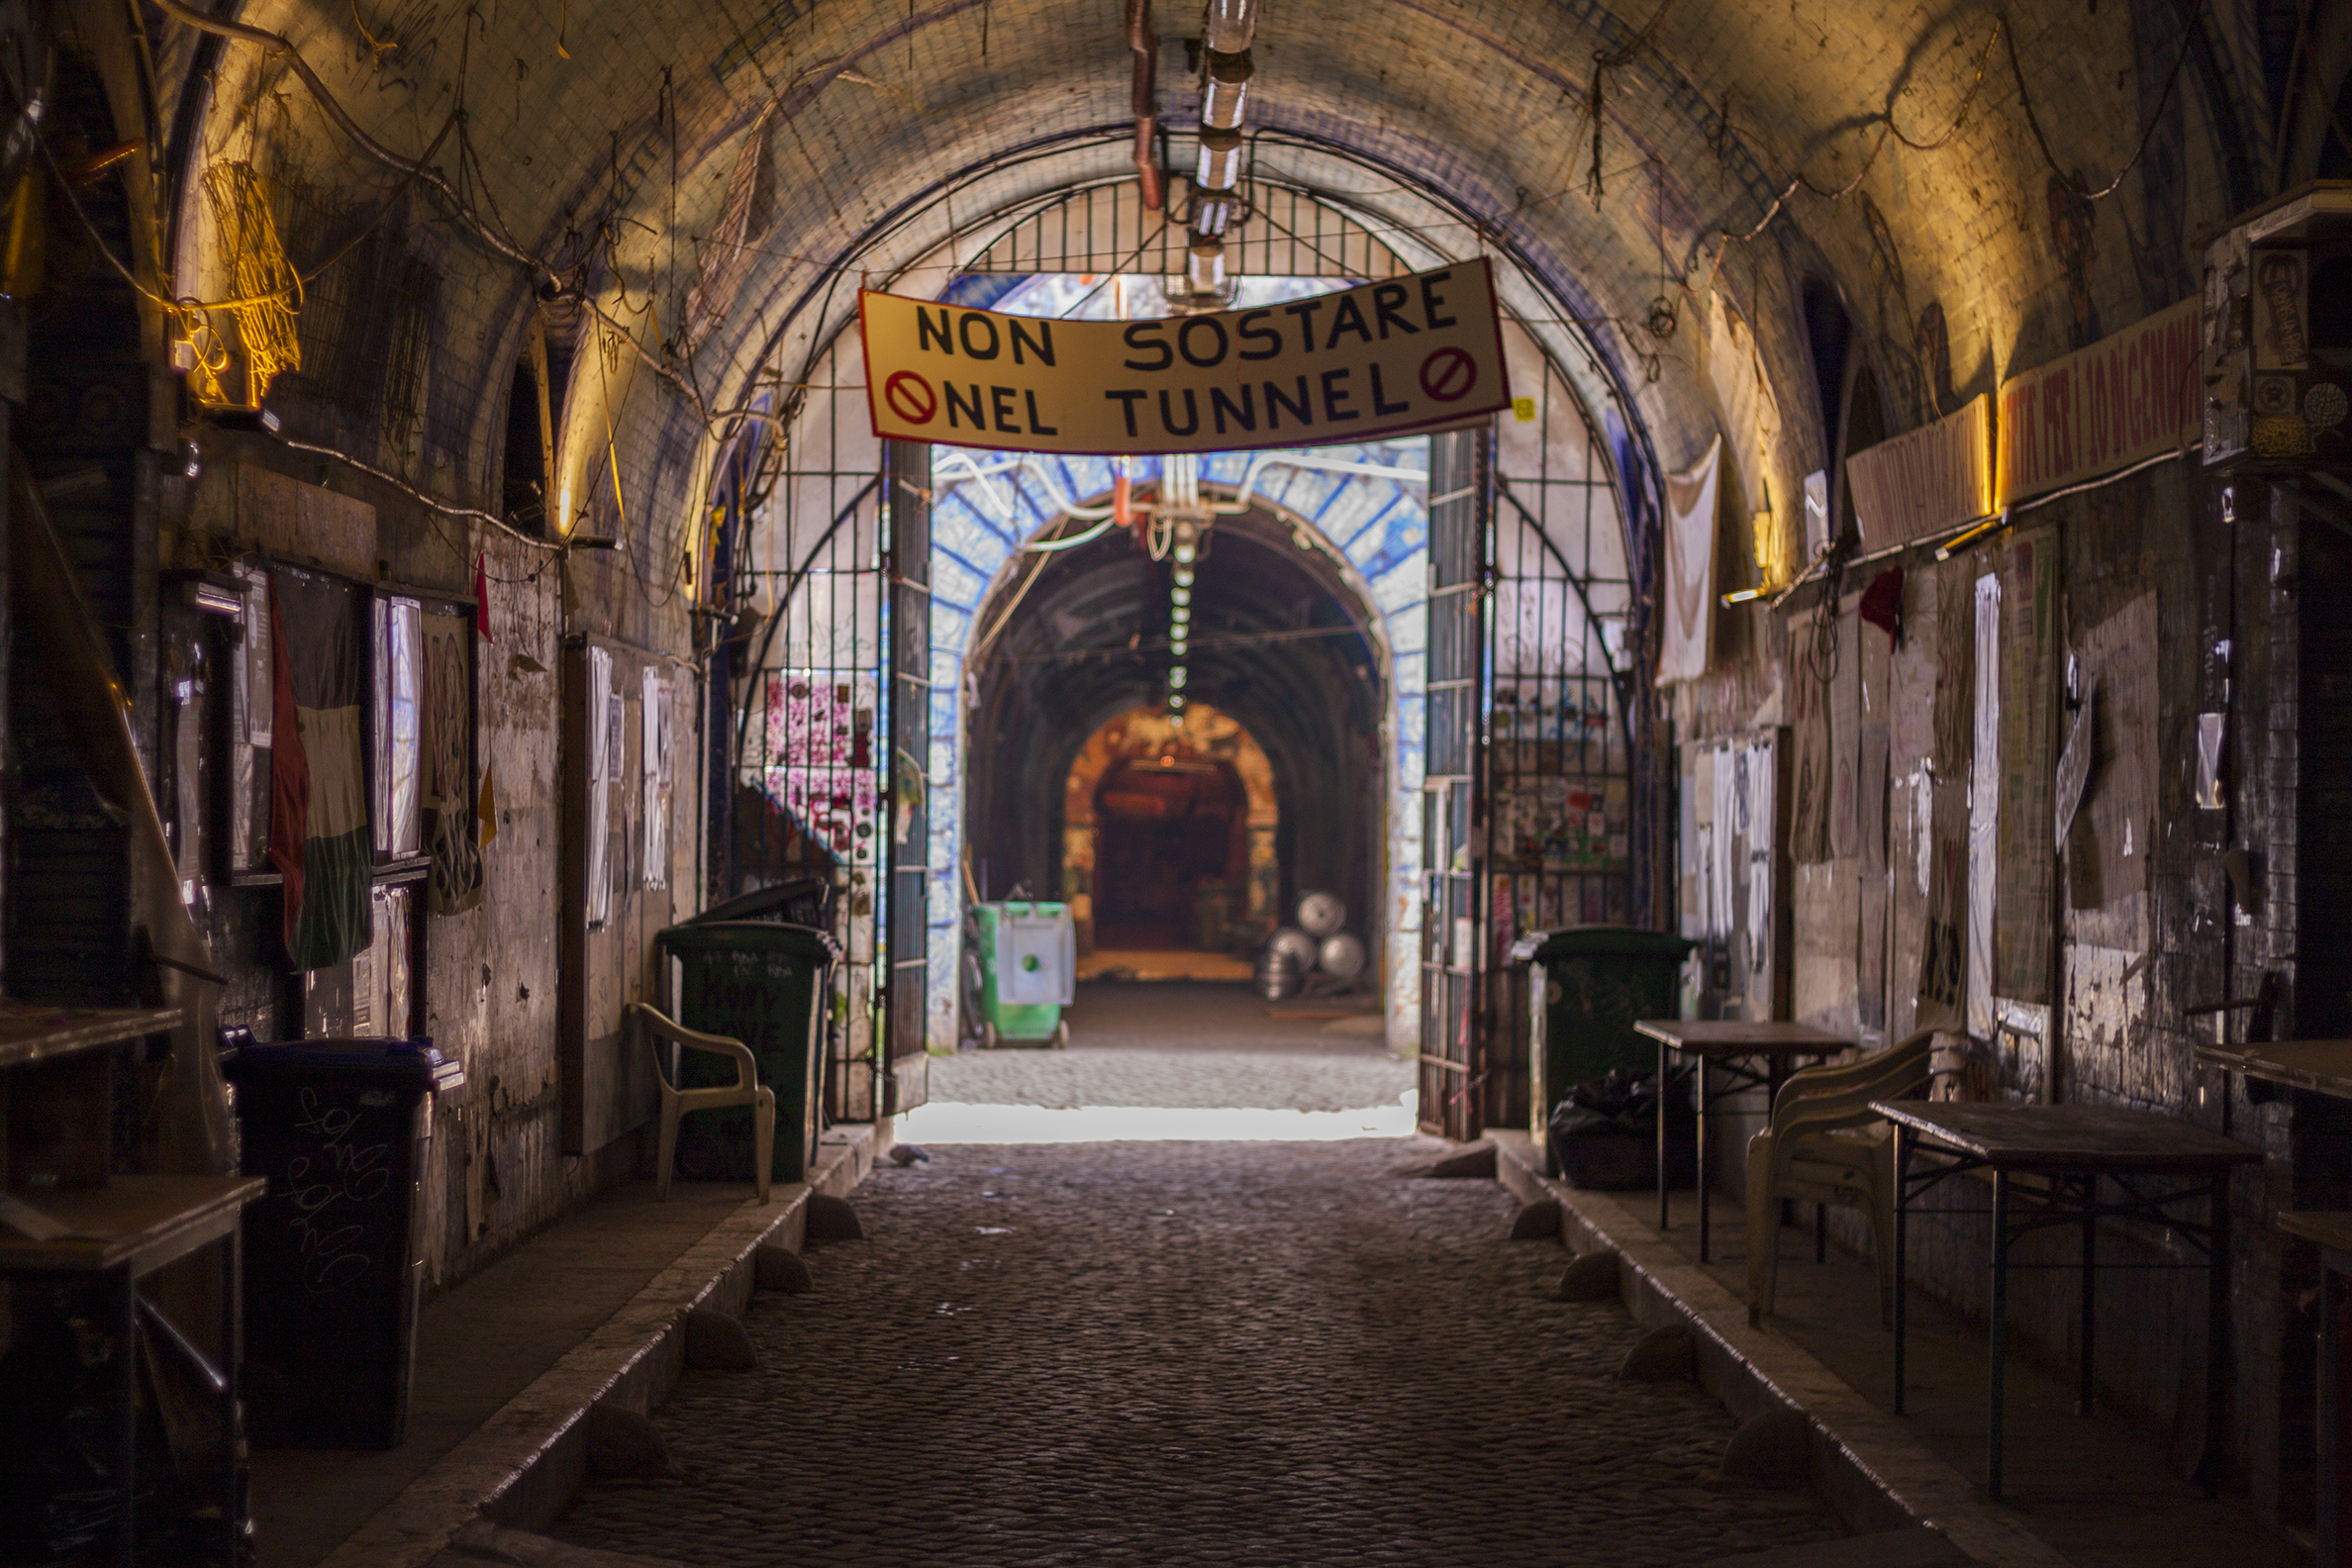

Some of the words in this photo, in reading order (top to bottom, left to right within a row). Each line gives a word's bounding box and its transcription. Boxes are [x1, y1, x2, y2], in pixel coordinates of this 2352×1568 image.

[917, 306, 1056, 367] NON
[1124, 271, 1458, 372] SOSTARE
[943, 380, 1057, 436] NEL
[1106, 362, 1410, 438] TUNNEL
[2042, 366, 2073, 478] PER
